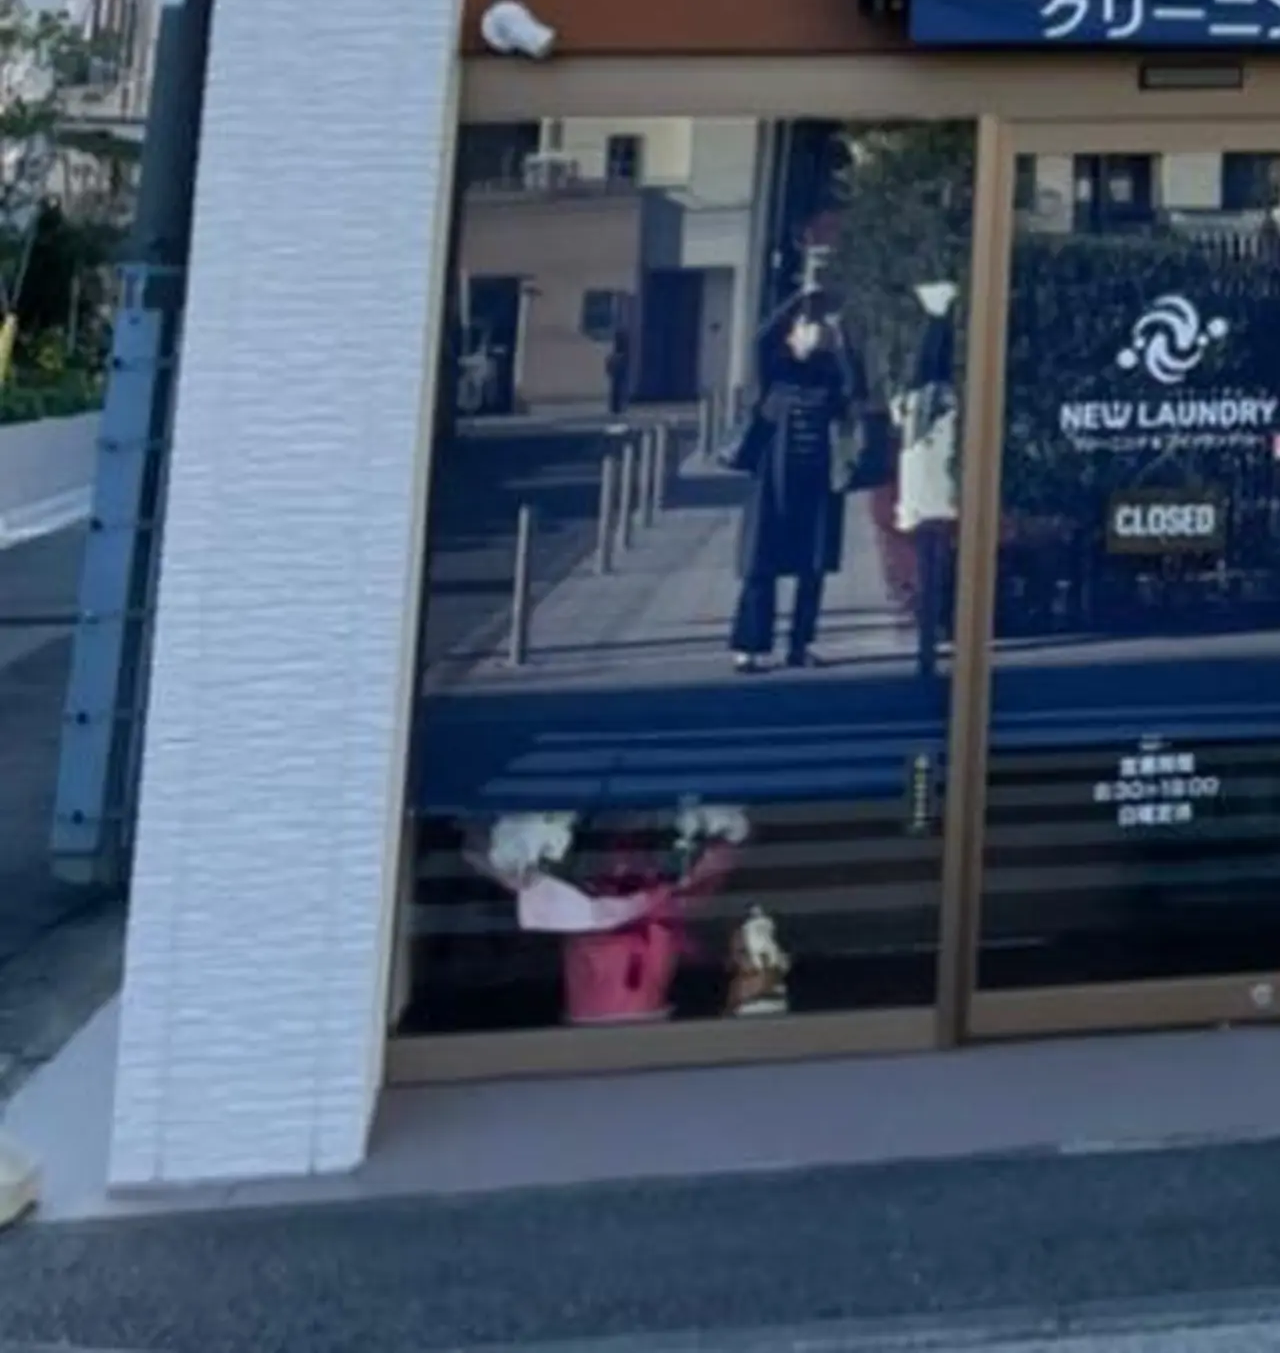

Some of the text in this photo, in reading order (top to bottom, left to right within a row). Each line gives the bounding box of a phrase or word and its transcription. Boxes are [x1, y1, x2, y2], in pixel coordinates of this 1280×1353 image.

[1060, 396, 1278, 430] NEW LAUNDRY
[1114, 503, 1215, 537] CLOSED
